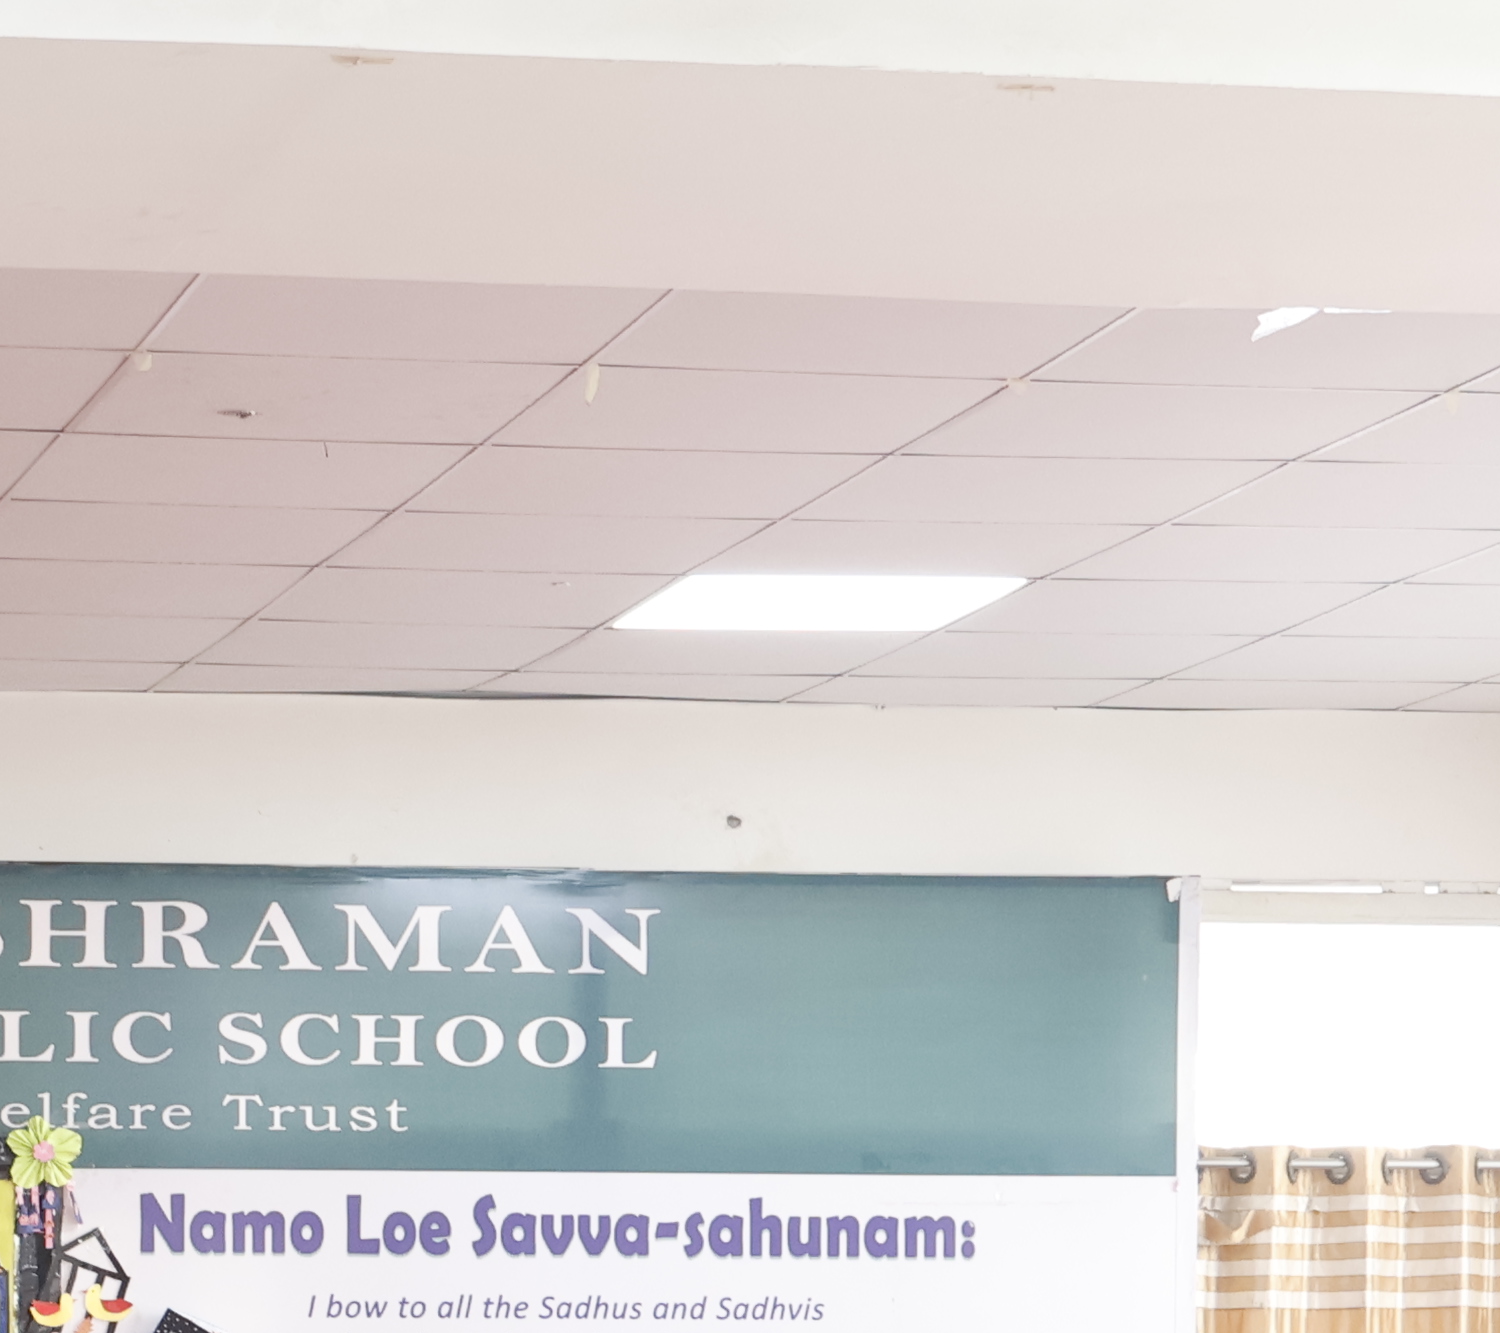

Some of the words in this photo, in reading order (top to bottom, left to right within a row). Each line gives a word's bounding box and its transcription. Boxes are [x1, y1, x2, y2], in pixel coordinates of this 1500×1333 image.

[219, 1011, 657, 1070] SCHOOL
[222, 1094, 410, 1132] Trust
[139, 1192, 323, 1255] Namo
[346, 1194, 450, 1257] Loe
[472, 1195, 977, 1259] Savva-sahunam:
[308, 1296, 315, 1318] I
[326, 1295, 387, 1319] bow
[399, 1297, 426, 1319] to
[438, 1295, 473, 1319] all
[483, 1296, 528, 1319] the
[538, 1296, 642, 1320] Sadhus
[653, 1297, 706, 1321] and
[716, 1297, 824, 1321] Sadhvis
